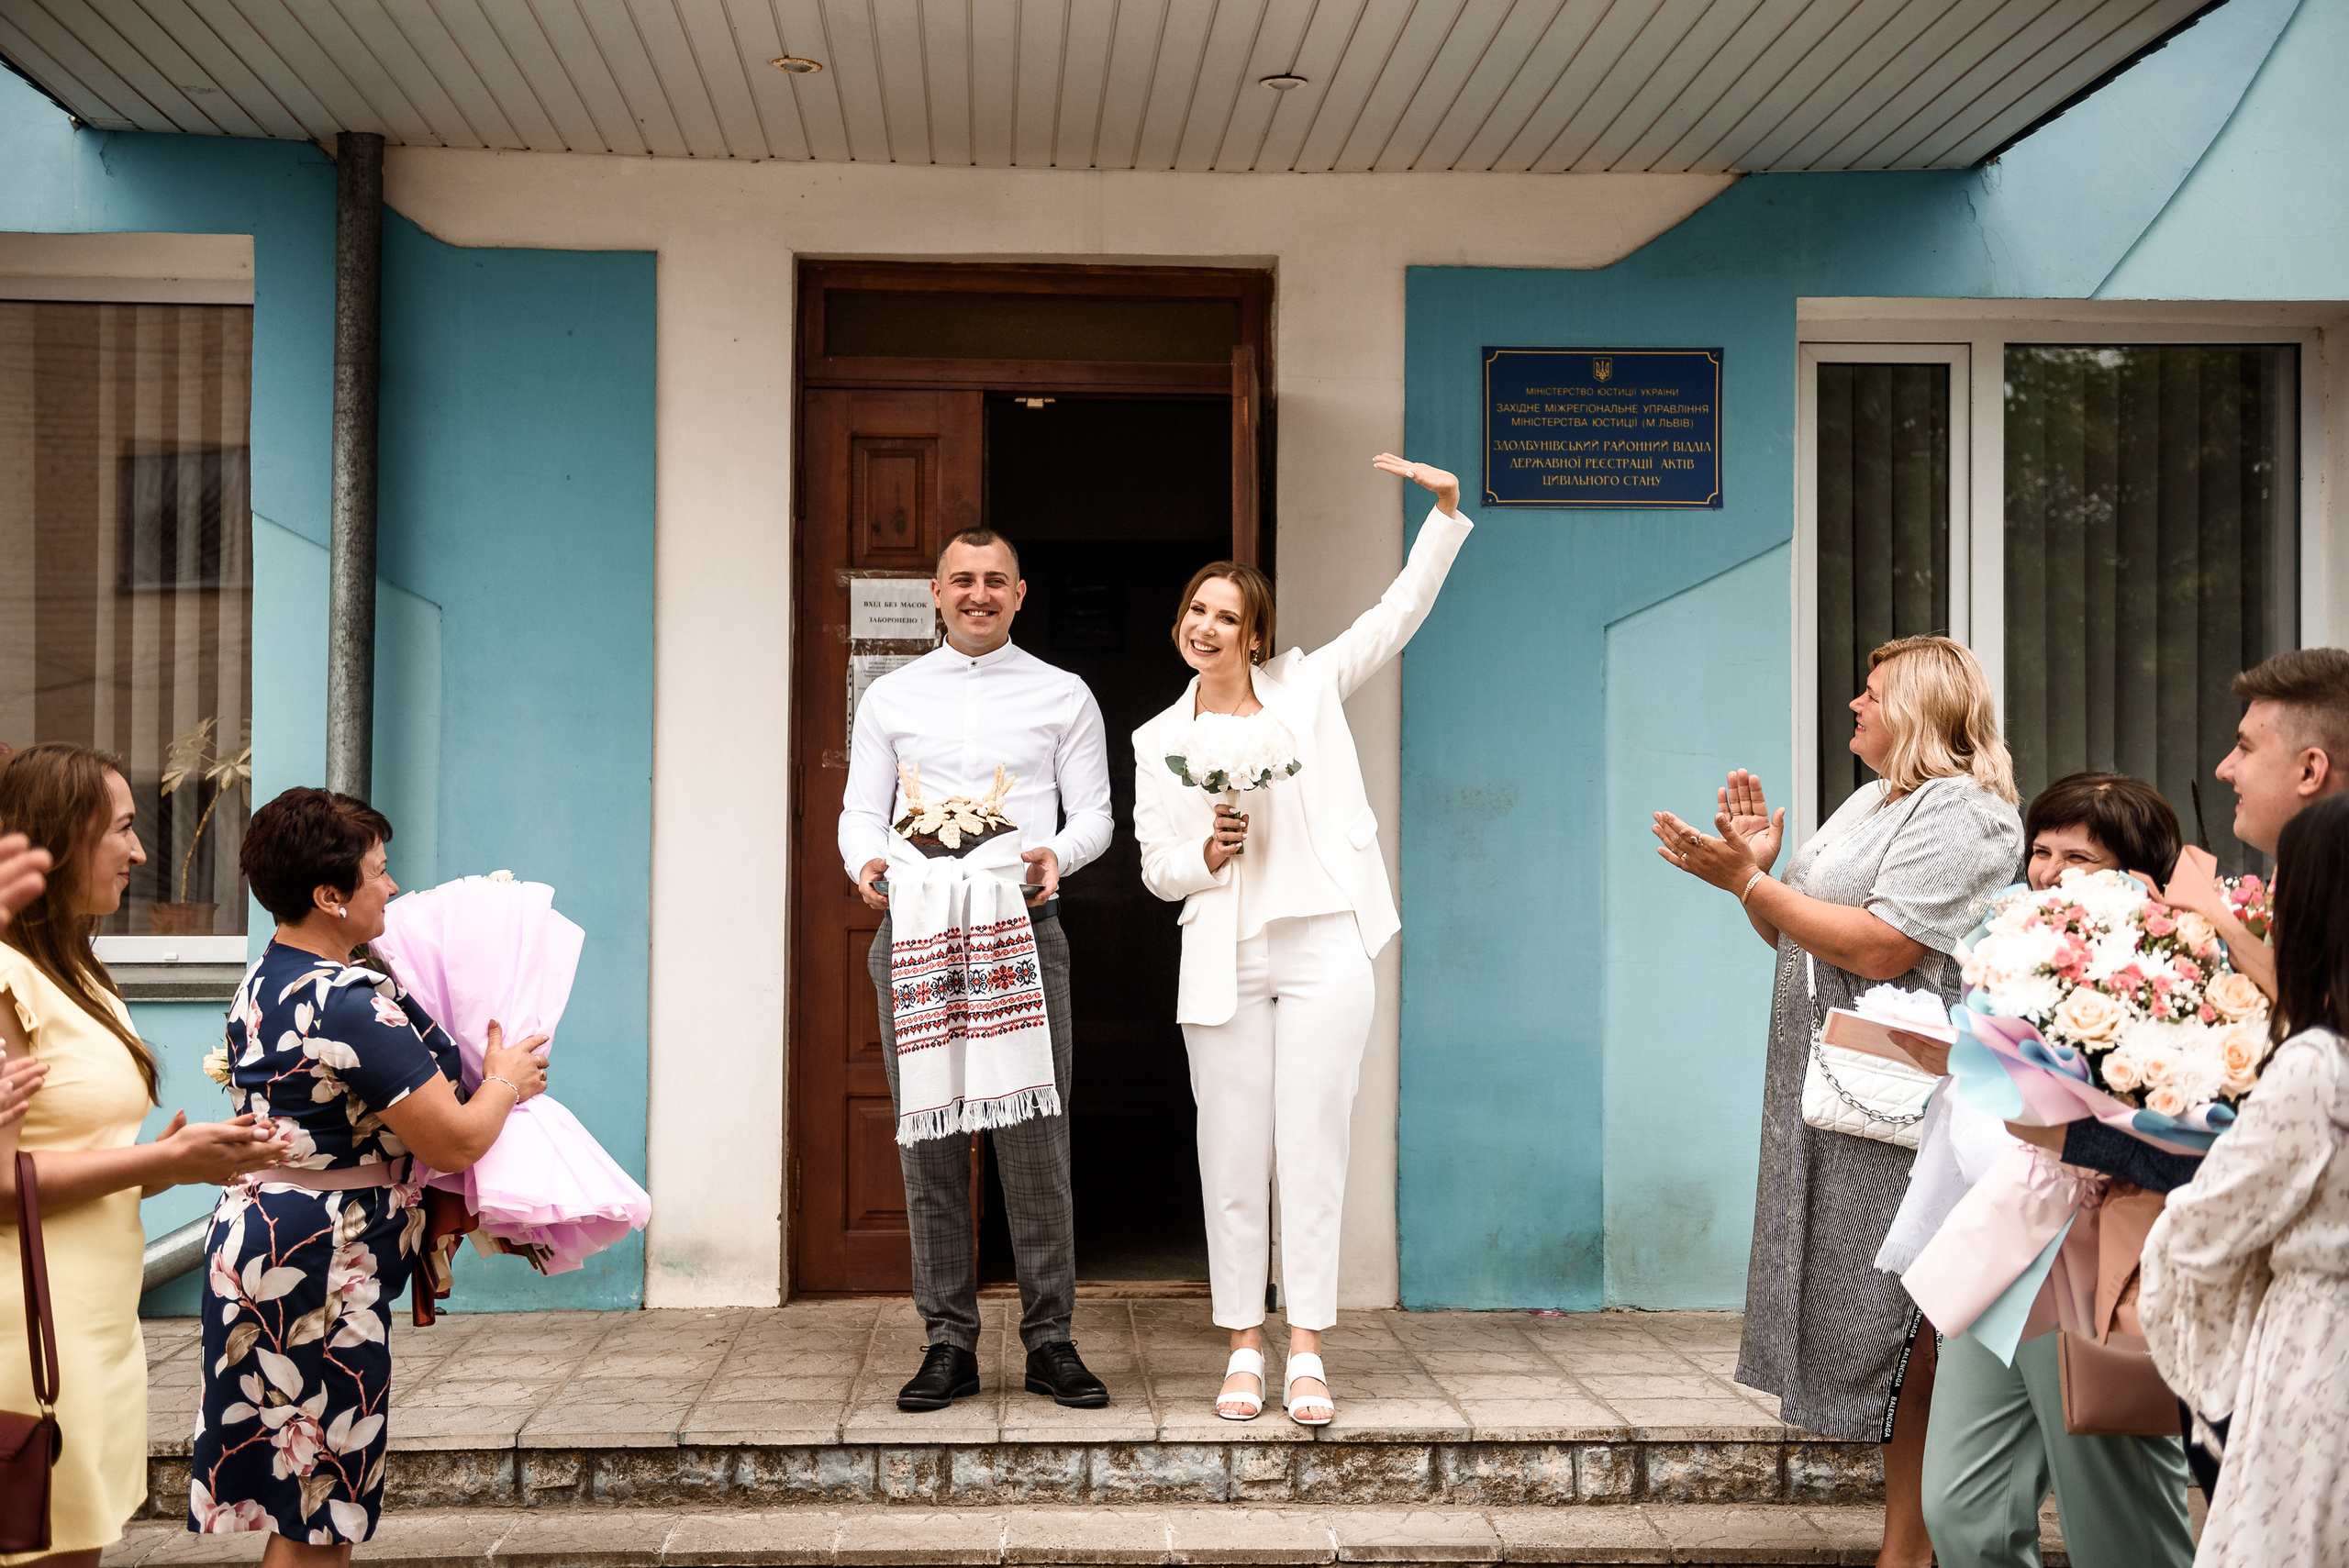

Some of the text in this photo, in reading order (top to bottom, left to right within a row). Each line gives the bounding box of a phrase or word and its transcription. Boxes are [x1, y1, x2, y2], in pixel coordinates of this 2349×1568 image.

[1526, 387, 1679, 397] МІНІСТЕРСТВО ЮСТИЦІЇ УКРАЇНИ
[1497, 403, 1709, 414] ЗАХІДНЕ МІЖРЕГІОНАЛЬНЕ УПРАВЛІННЯ
[1511, 417, 1588, 428] МІНІСТЕРСТВА
[1592, 417, 1638, 428] ЮСТИЦІЇ
[1493, 439, 1711, 452] ЗДОЛБУНІВСЬКИЙ РАЙОННИЙ ВІДДІЛ
[1509, 456, 1695, 469] ДЕРЖАВНОЇ РЕЄСТРАЦІЇ АКТІВ
[1542, 475, 1662, 486] ЦИВІЛЬНОГО СТАНУ
[1909, 1307, 1923, 1338] ENCIAGA
[1894, 1347, 1910, 1388] BALENCIAGA
[1884, 1396, 1898, 1438] BALENCIAGA
